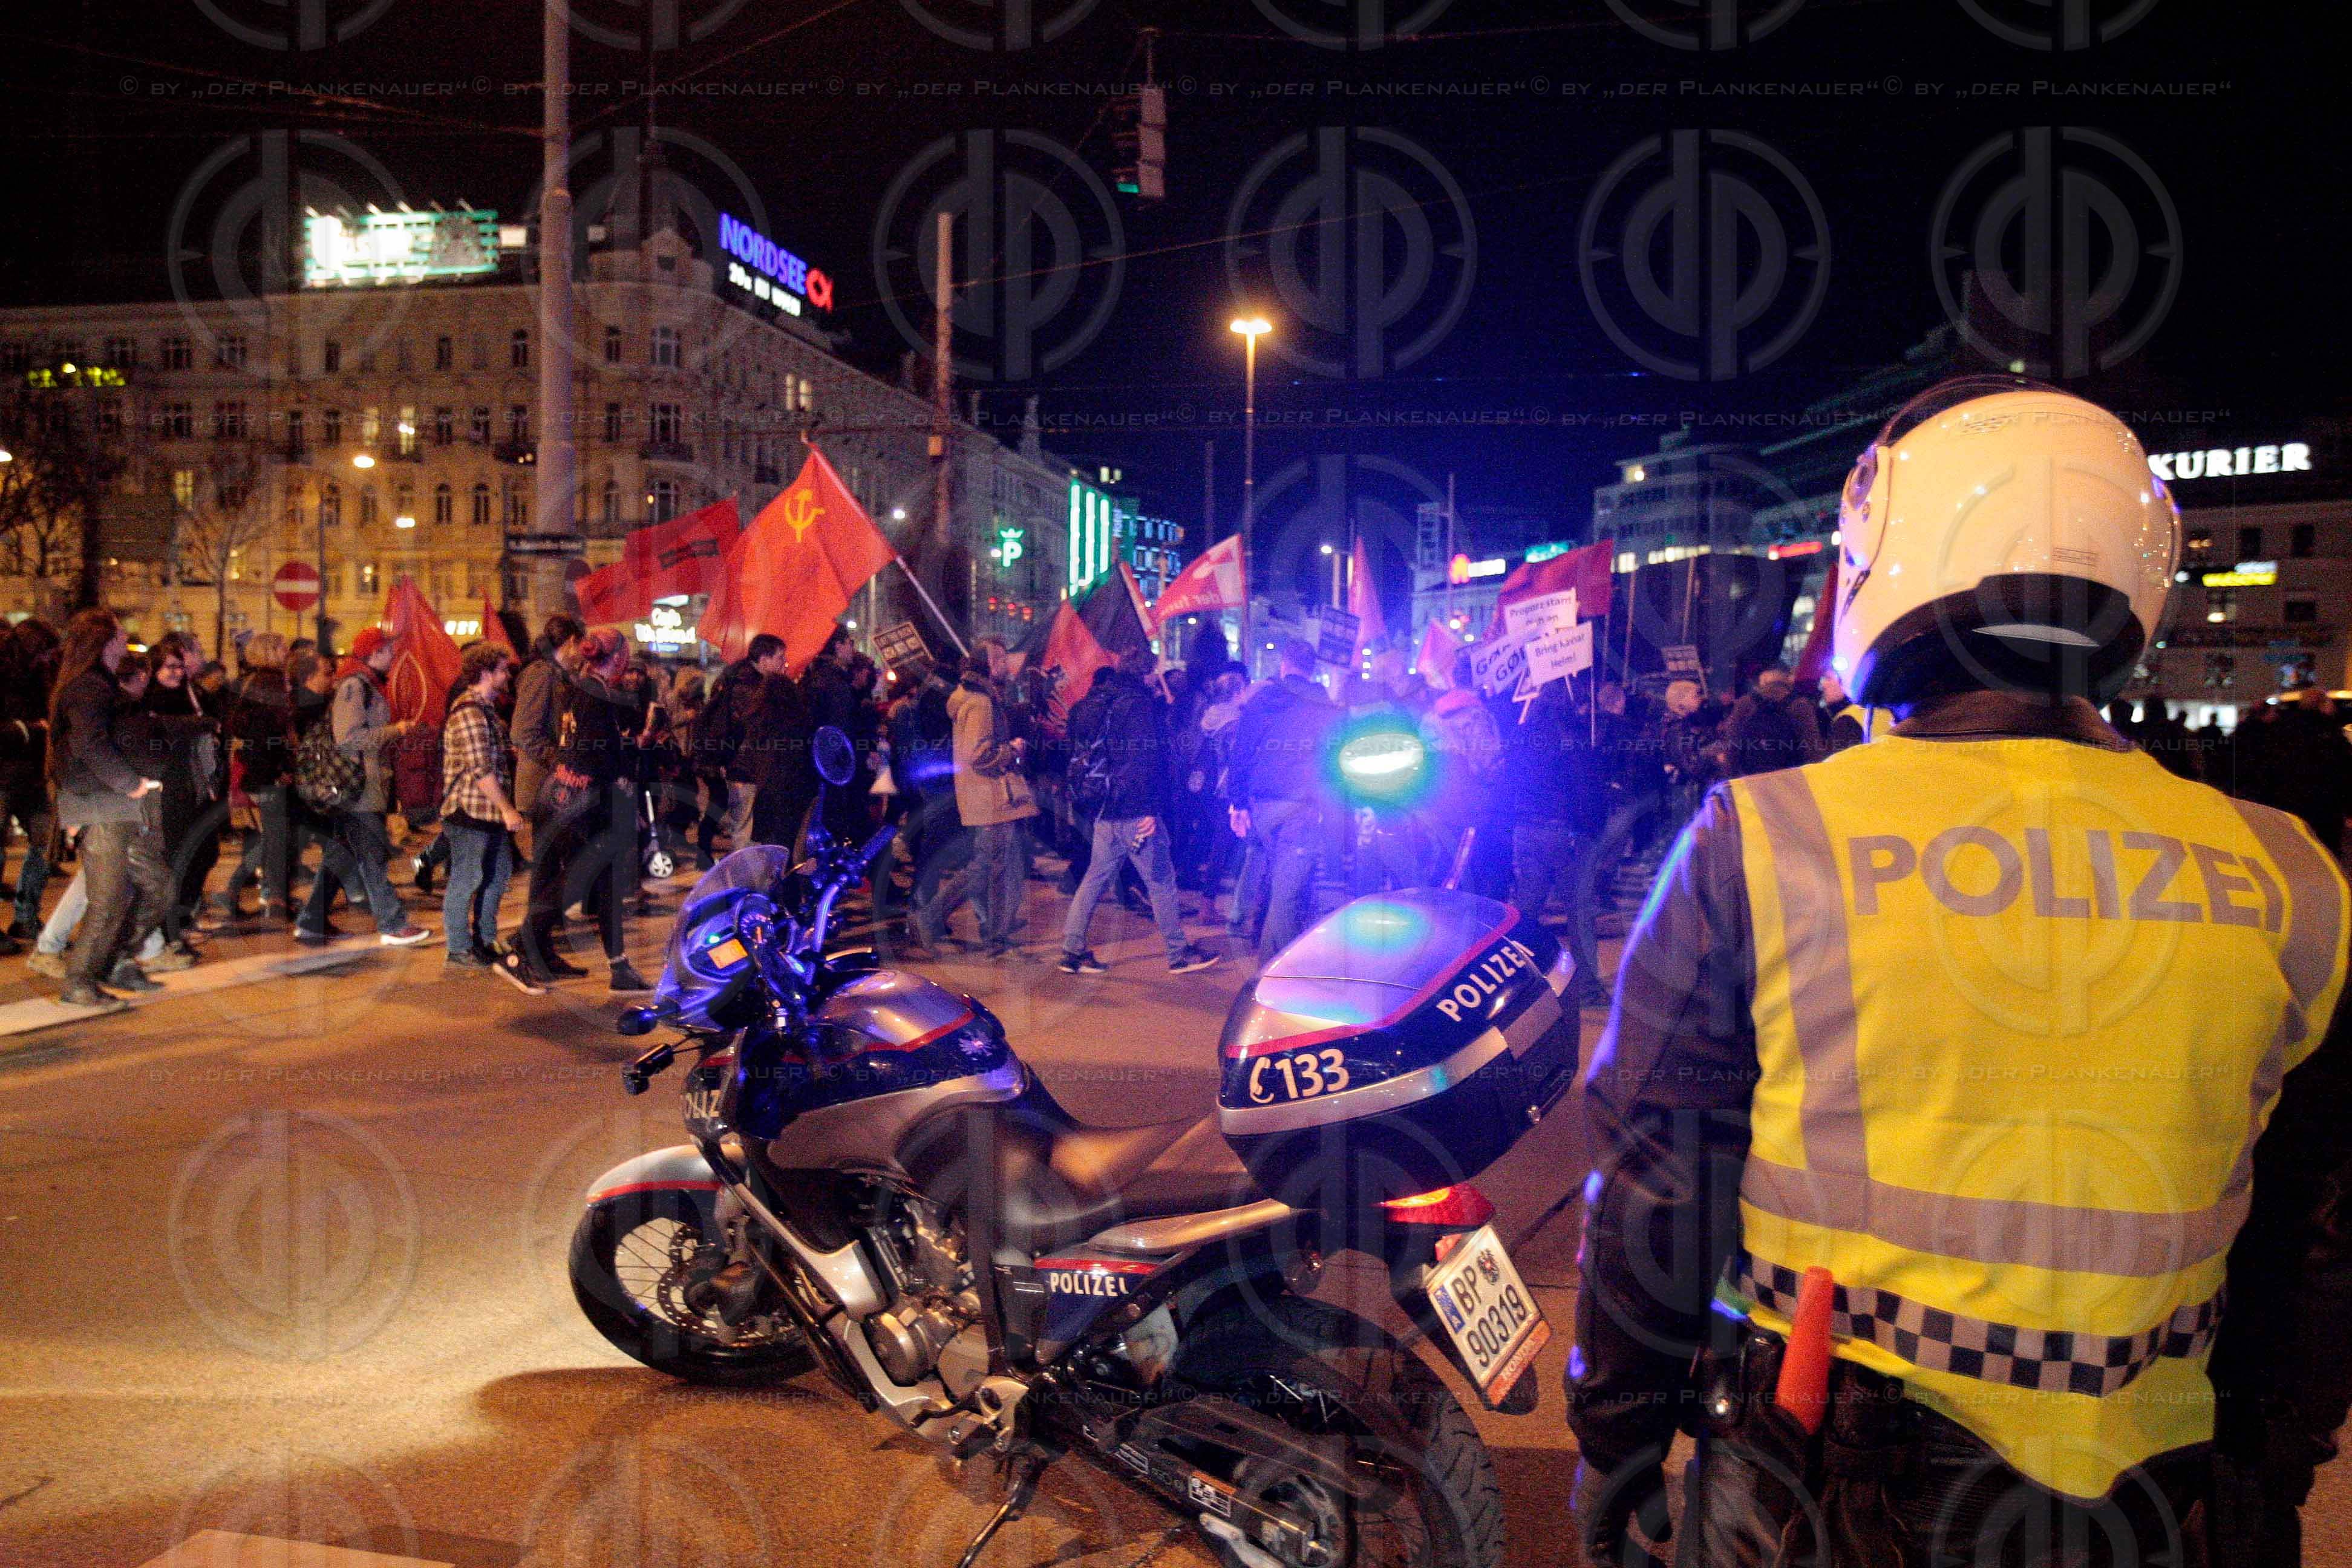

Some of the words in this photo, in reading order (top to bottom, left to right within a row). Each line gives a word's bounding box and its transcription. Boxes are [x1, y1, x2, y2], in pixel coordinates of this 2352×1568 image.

[720, 212, 808, 296] NORDSEE
[2148, 442, 2313, 481] KURIER
[1847, 825, 2286, 935] POLIZEI
[1436, 940, 1535, 1022] POLIZEI
[1275, 1048, 1350, 1099] 133
[1050, 1272, 1129, 1297] POLIZEI
[1451, 1265, 1481, 1316] BP
[1467, 1283, 1527, 1368] 90319
